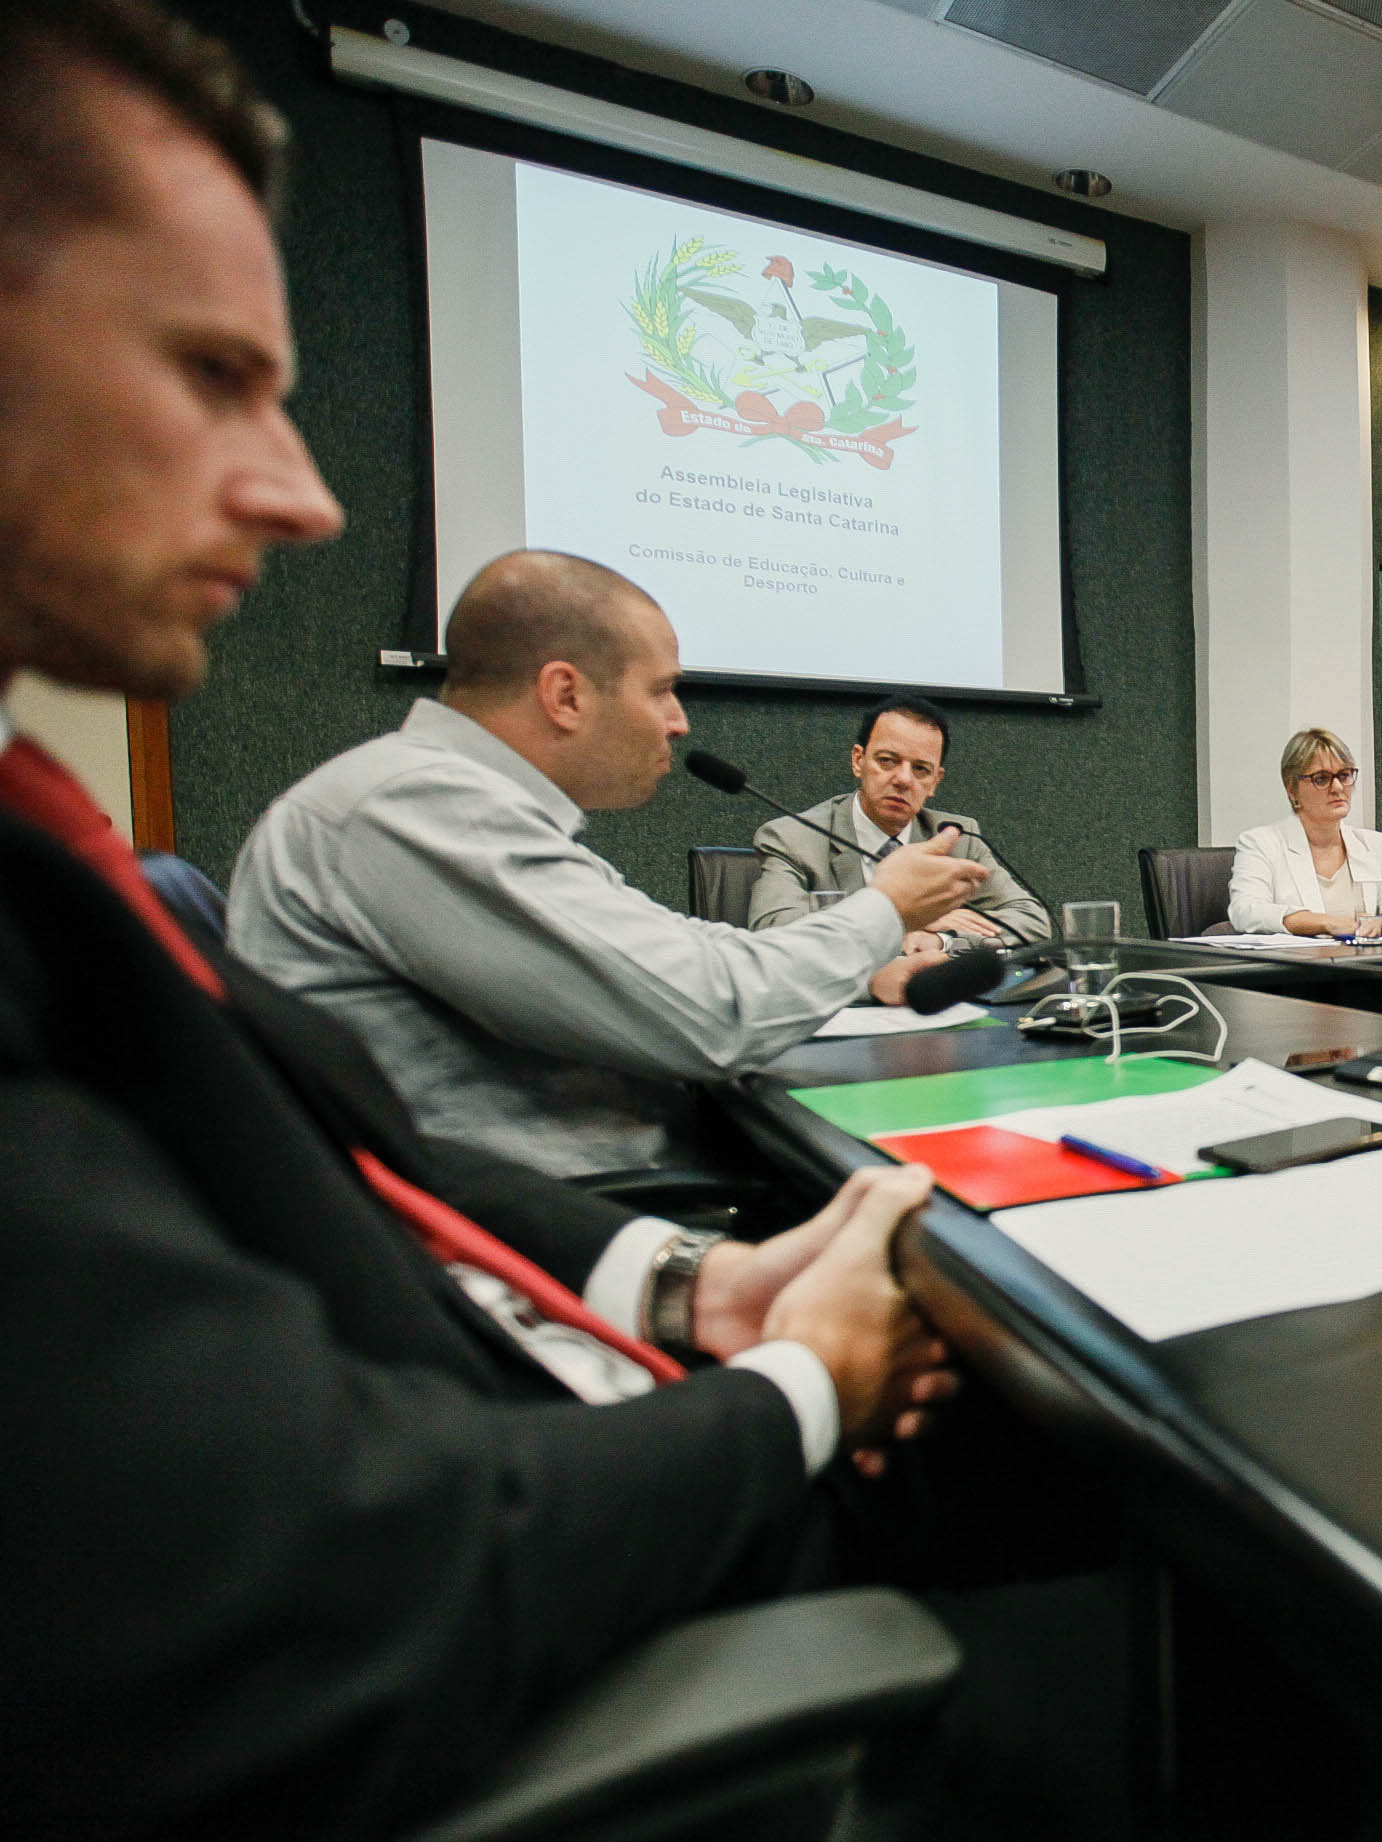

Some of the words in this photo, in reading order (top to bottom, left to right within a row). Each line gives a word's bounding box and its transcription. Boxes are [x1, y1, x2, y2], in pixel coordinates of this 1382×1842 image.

[680, 410, 731, 430] Estado
[829, 435, 885, 457] Catarina
[660, 464, 771, 494] Assembleia
[778, 482, 873, 509] Legislativa
[635, 489, 661, 505] do
[669, 491, 736, 515] Estado
[743, 502, 765, 518] de
[771, 505, 823, 527] Santa
[828, 513, 899, 537] Catarina
[628, 543, 717, 566] Comissão
[722, 553, 742, 569] de
[748, 556, 833, 579] Educação,
[838, 566, 892, 586] Cultura
[896, 575, 905, 586] e
[743, 574, 818, 595] Desporto
